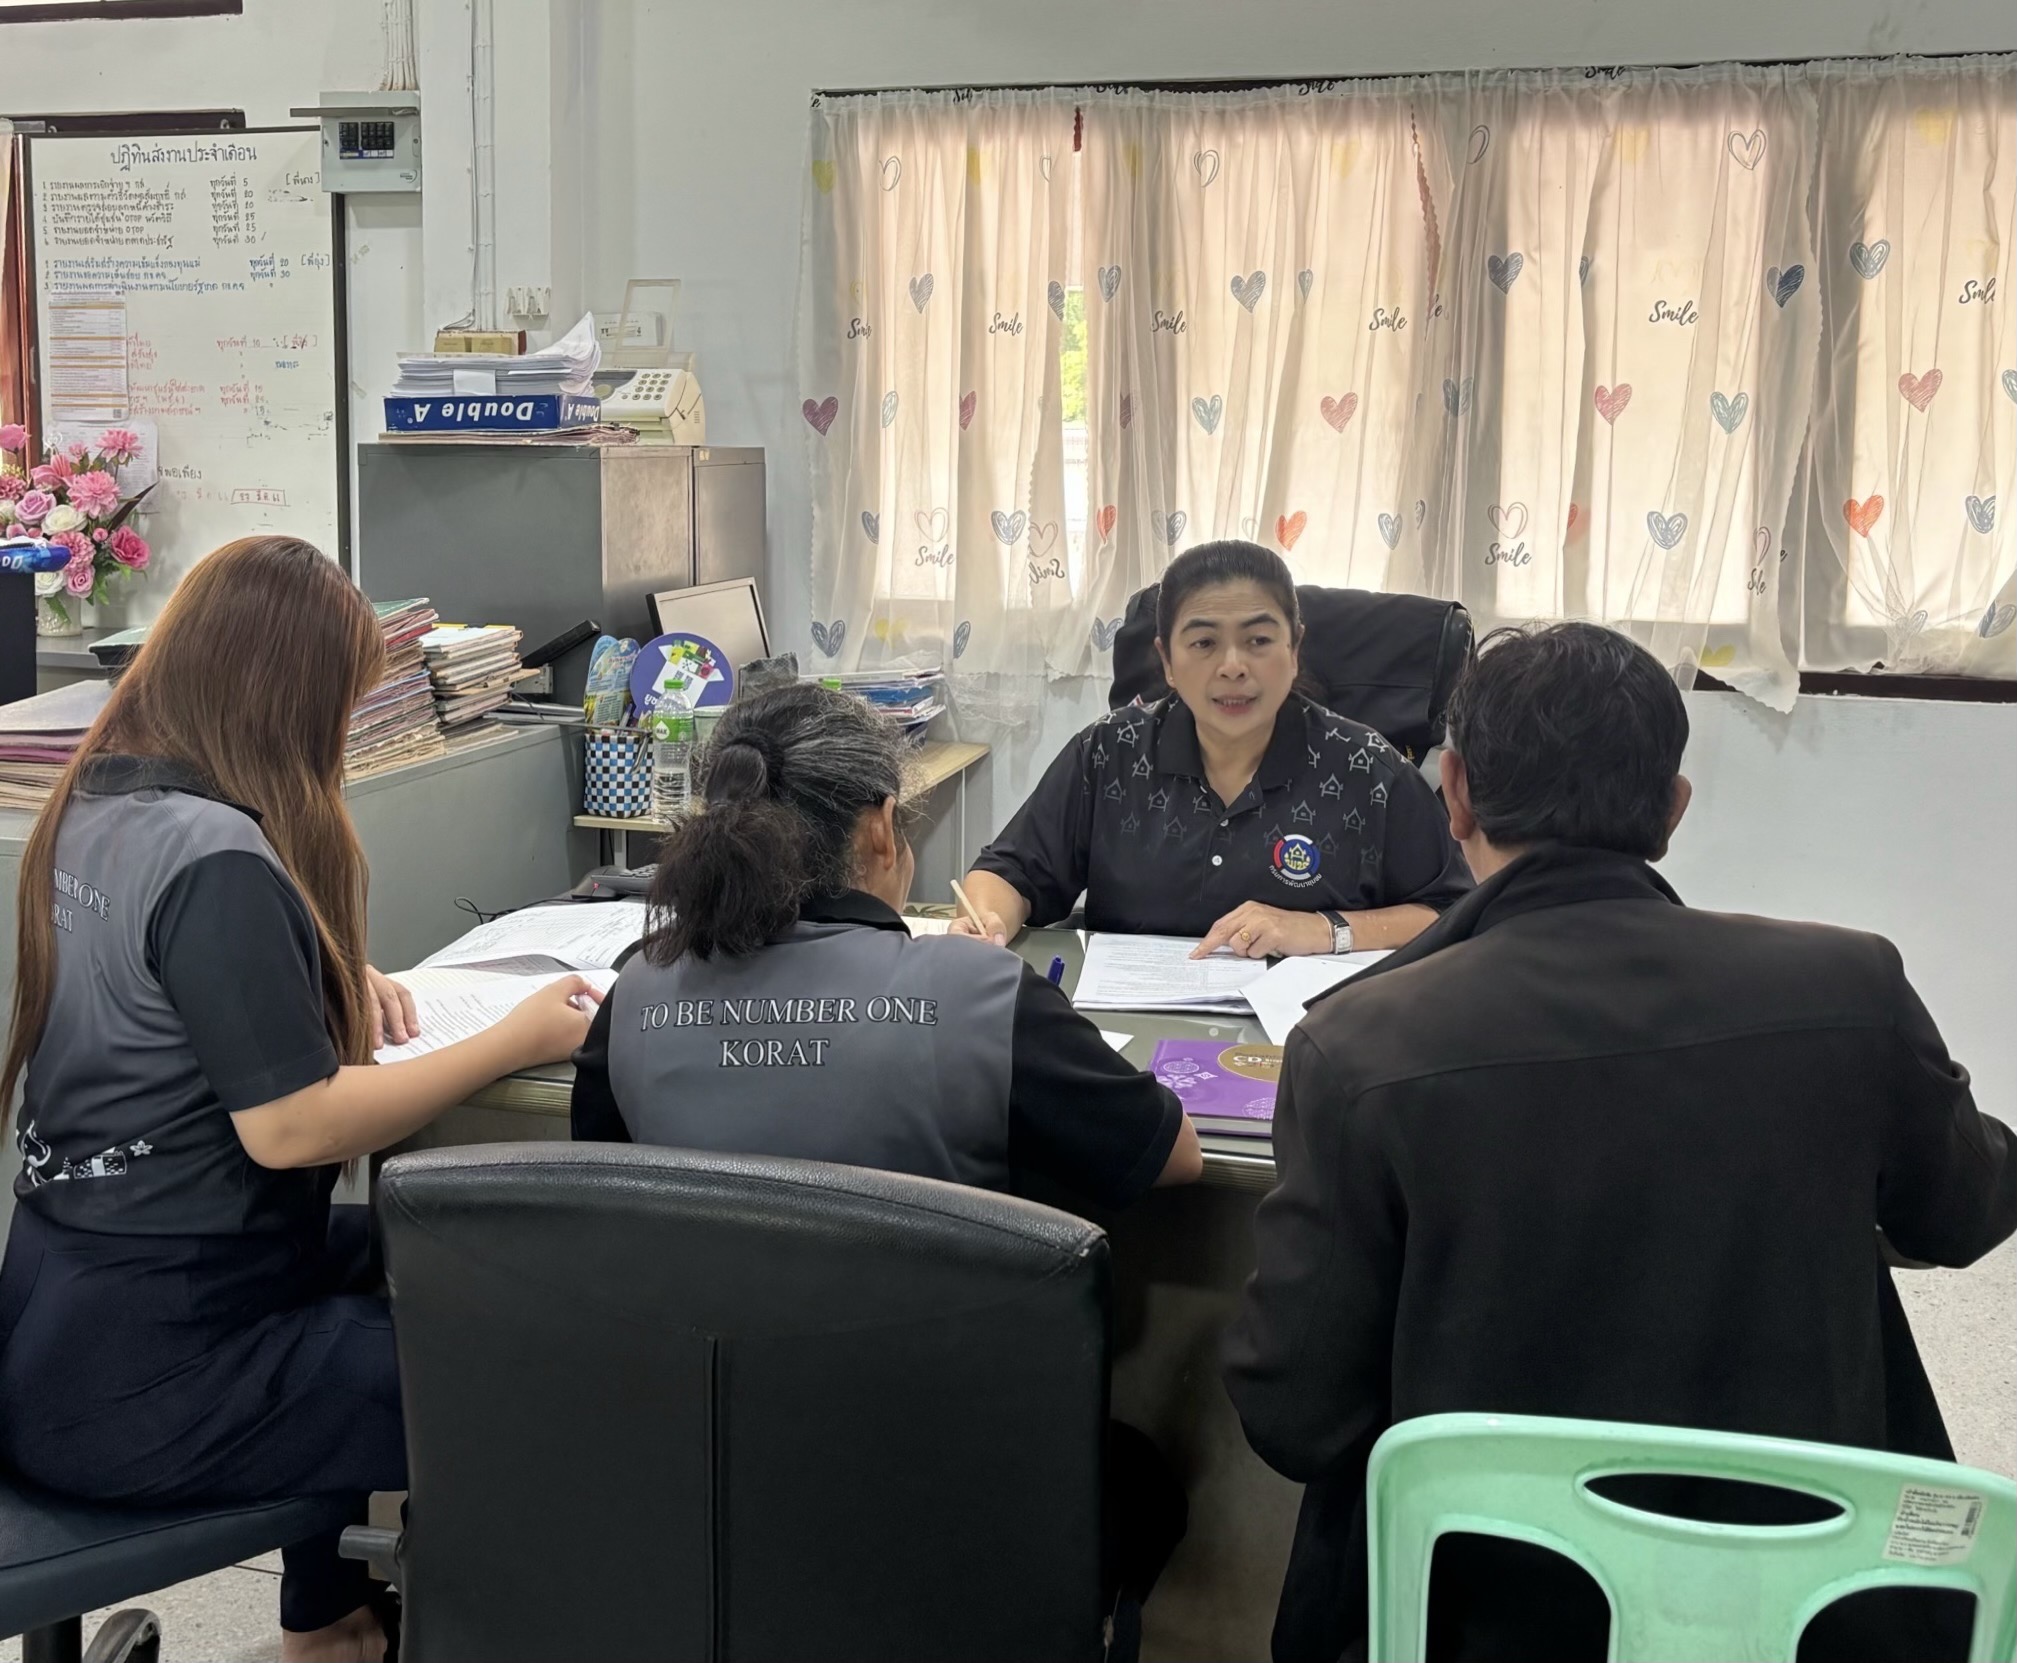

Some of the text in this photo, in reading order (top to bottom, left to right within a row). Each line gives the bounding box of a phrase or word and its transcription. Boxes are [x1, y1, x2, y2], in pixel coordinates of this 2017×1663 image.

[243, 177, 249, 187] 5
[988, 312, 1024, 336] Smile
[1151, 310, 1187, 335] Smile
[1368, 306, 1408, 332] Smile
[1648, 299, 1699, 326] Smile
[414, 402, 534, 422] Double A
[567, 403, 600, 422] Double A
[914, 544, 955, 568] Smile
[1484, 542, 1532, 567] Smile
[79, 883, 111, 922] ONE
[640, 995, 938, 1032] TO BE NUMBER ONE
[718, 1038, 831, 1068] KORAT
